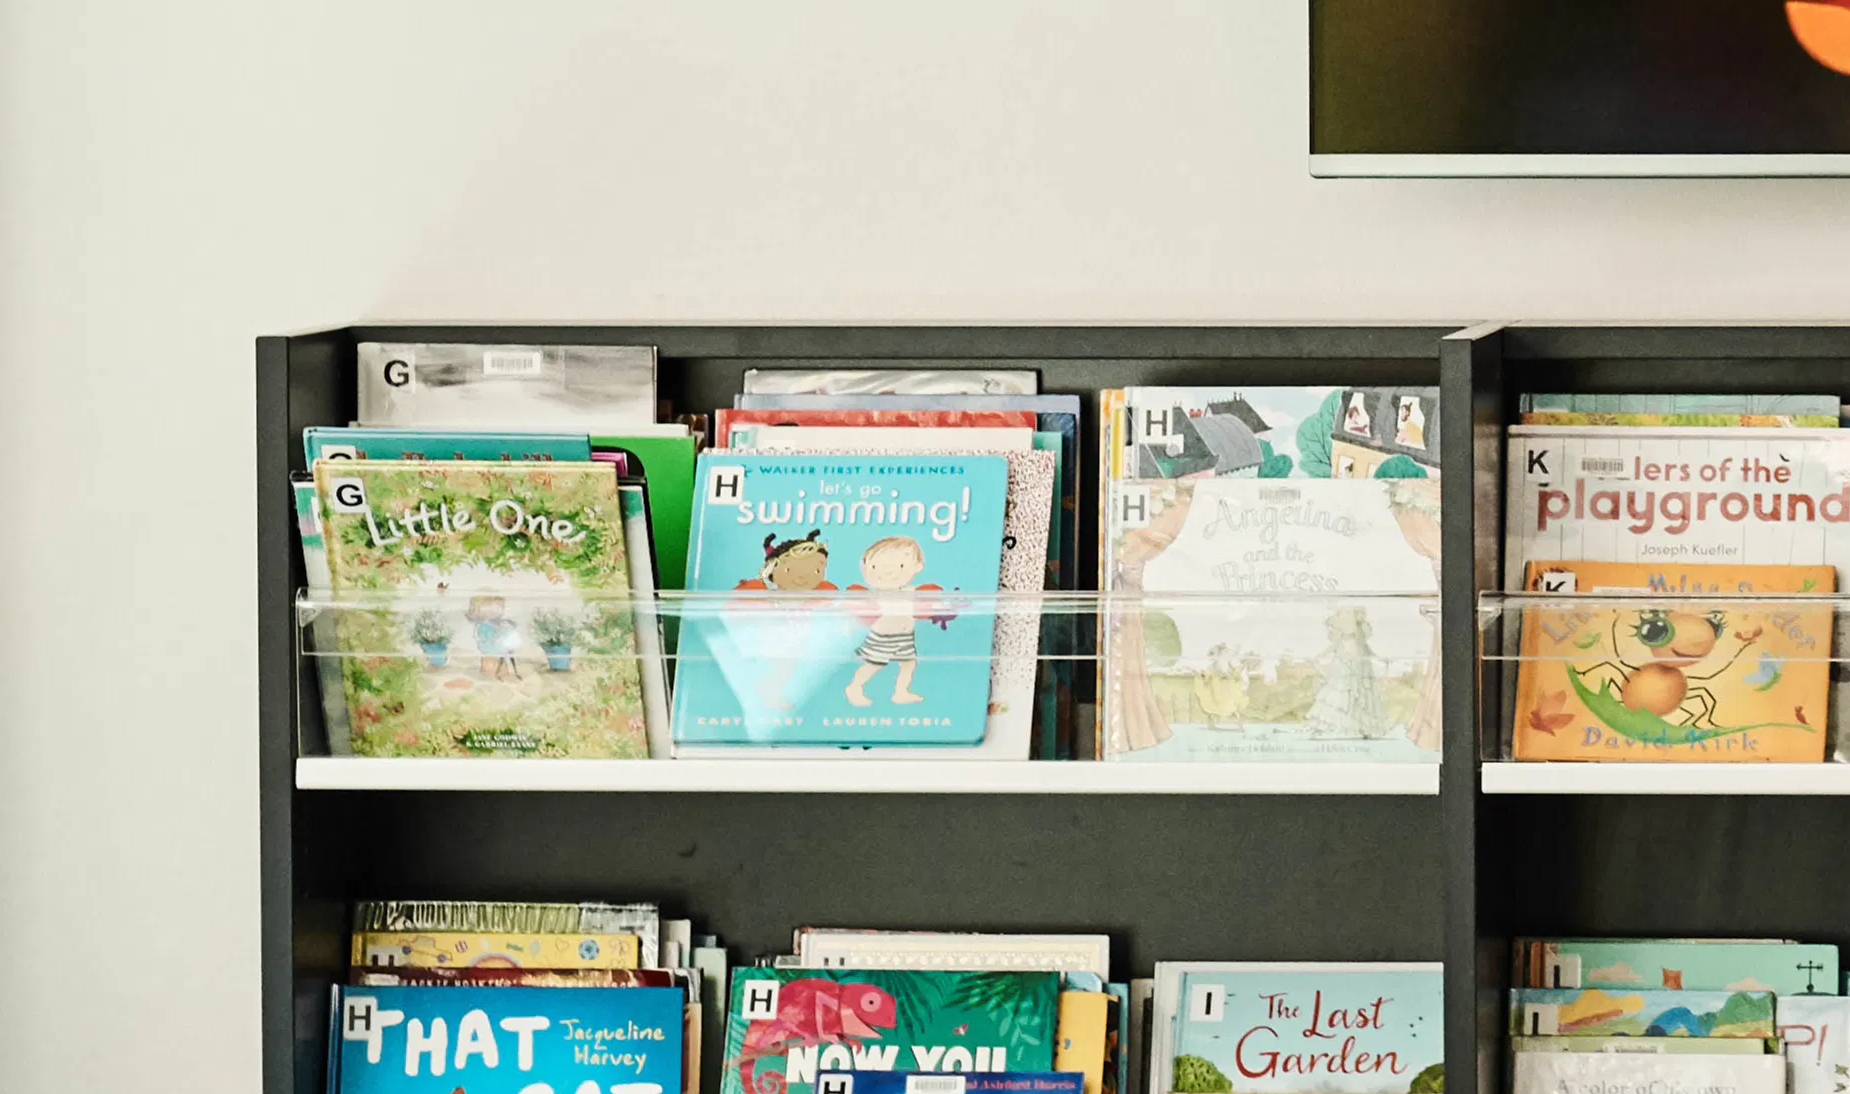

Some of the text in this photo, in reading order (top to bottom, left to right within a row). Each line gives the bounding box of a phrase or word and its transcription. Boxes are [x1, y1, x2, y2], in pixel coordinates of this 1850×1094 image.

[384, 360, 410, 386] G
[823, 465, 965, 475] FIRST EXPERIENCES
[1528, 450, 1549, 474] K
[1700, 456, 1732, 482] of
[715, 475, 739, 498] H
[860, 483, 882, 499] go
[363, 500, 586, 546] Little One
[736, 486, 971, 541] swimming!
[750, 988, 774, 1014] H
[1258, 990, 1394, 1040] The Last
[574, 1045, 648, 1073] Harvey
[1234, 1026, 1409, 1080] Garden
